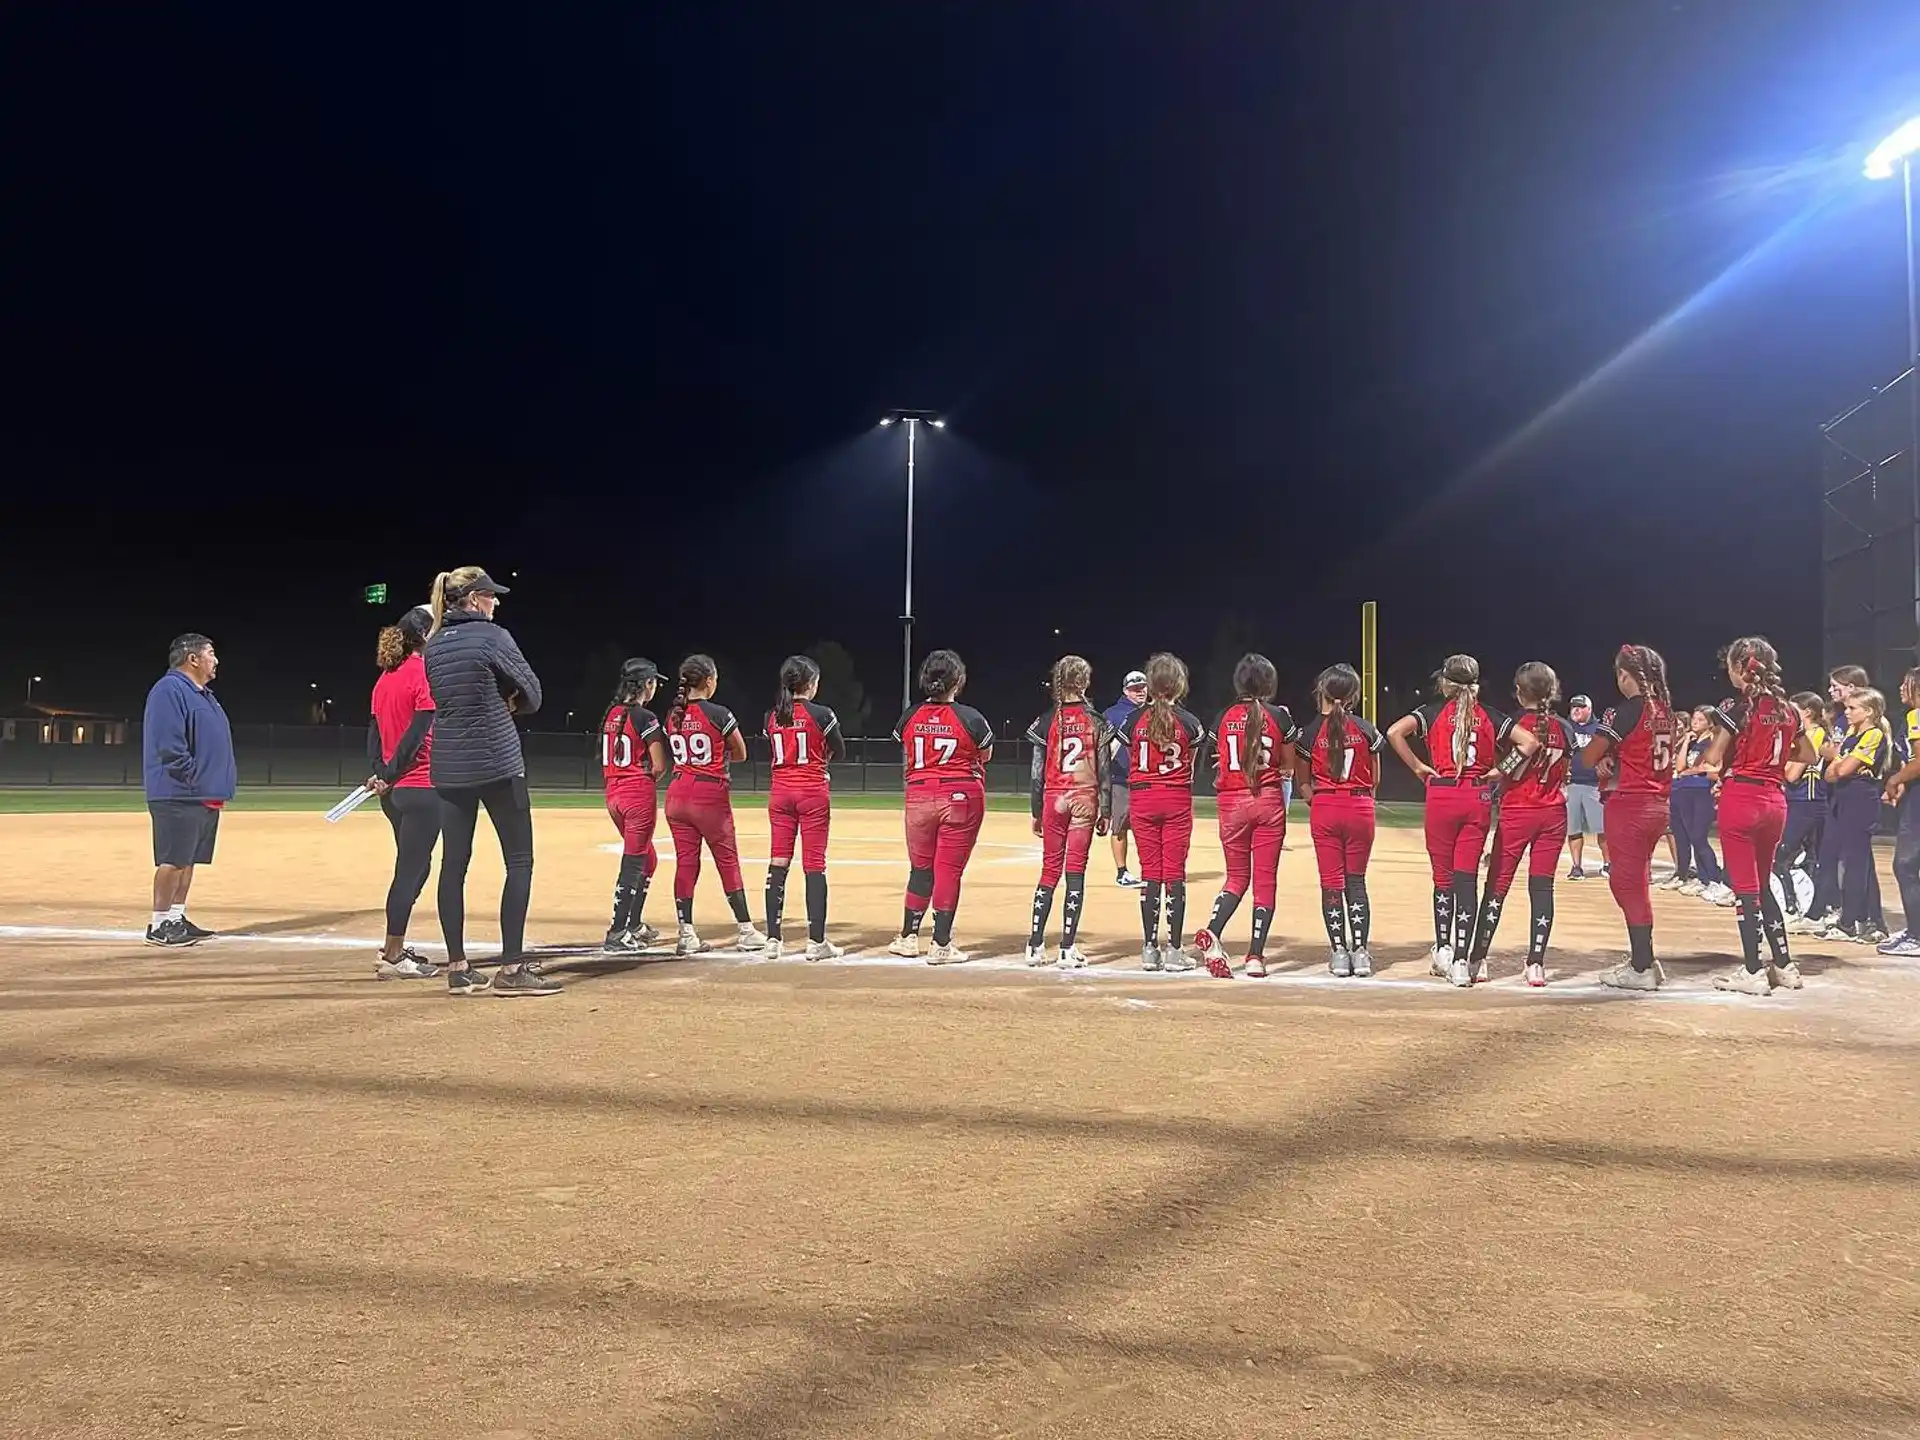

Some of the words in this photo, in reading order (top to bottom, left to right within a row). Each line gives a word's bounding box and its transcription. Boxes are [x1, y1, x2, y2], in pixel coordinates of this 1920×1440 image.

[602, 733, 631, 767] 10
[670, 733, 712, 765] 99
[773, 732, 808, 765] 11
[914, 736, 957, 769] 17
[1062, 737, 1085, 772] 2
[1138, 741, 1182, 774] 13
[1452, 731, 1477, 767] 6
[1653, 734, 1671, 770] 5
[1769, 730, 1783, 766] 1
